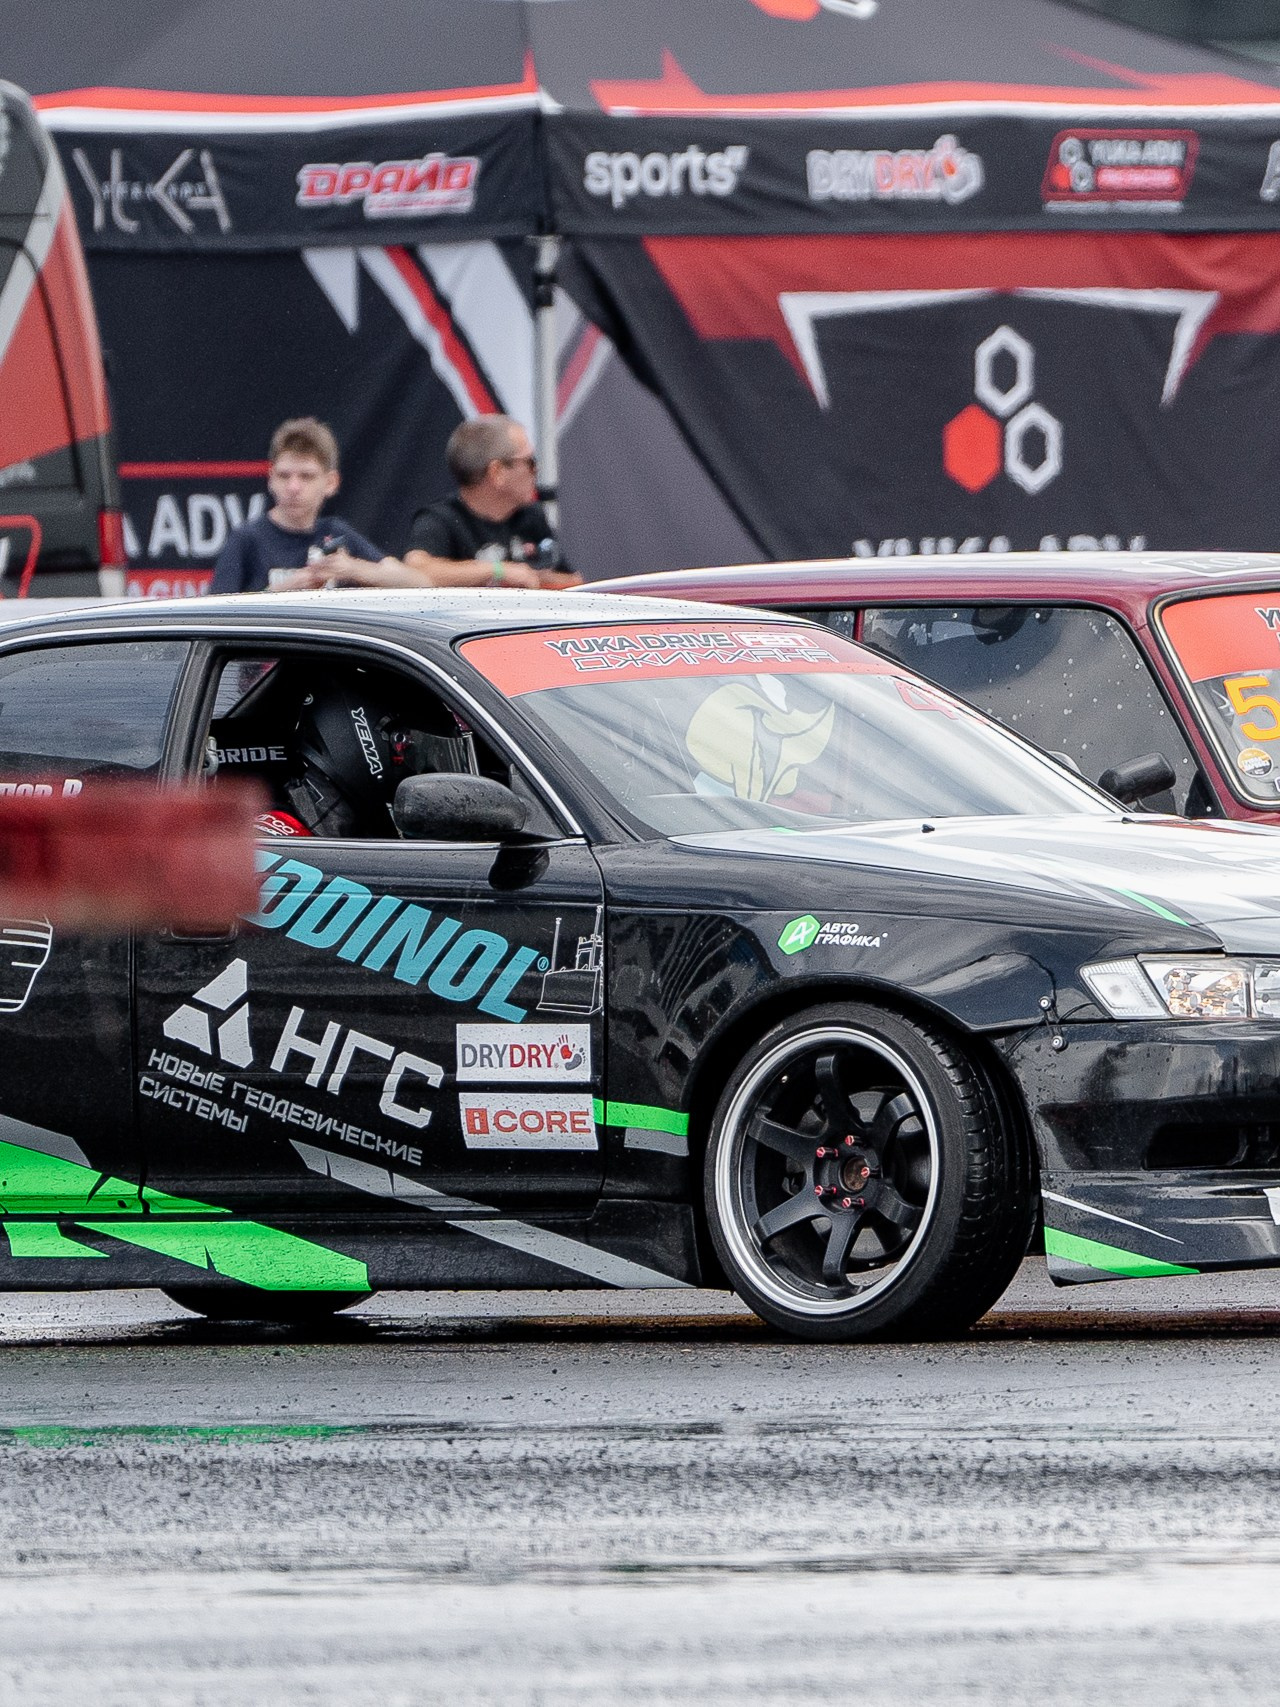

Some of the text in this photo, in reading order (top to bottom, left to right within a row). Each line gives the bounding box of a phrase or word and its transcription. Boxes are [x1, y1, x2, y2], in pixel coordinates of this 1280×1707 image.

[636, 632, 735, 653] DRIVE
[351, 706, 384, 776] YEMA
[215, 746, 288, 764] BRIDE
[814, 933, 881, 948] ГРАФИКА
[819, 922, 860, 935] АВТО
[269, 1005, 445, 1129] НГС
[461, 1043, 558, 1069] DRYDRY
[138, 1075, 250, 1134] СИСТЕМЫ
[147, 1048, 424, 1167] НОВЫЕ ГЕОДЕЗИЧЕСКИЕ
